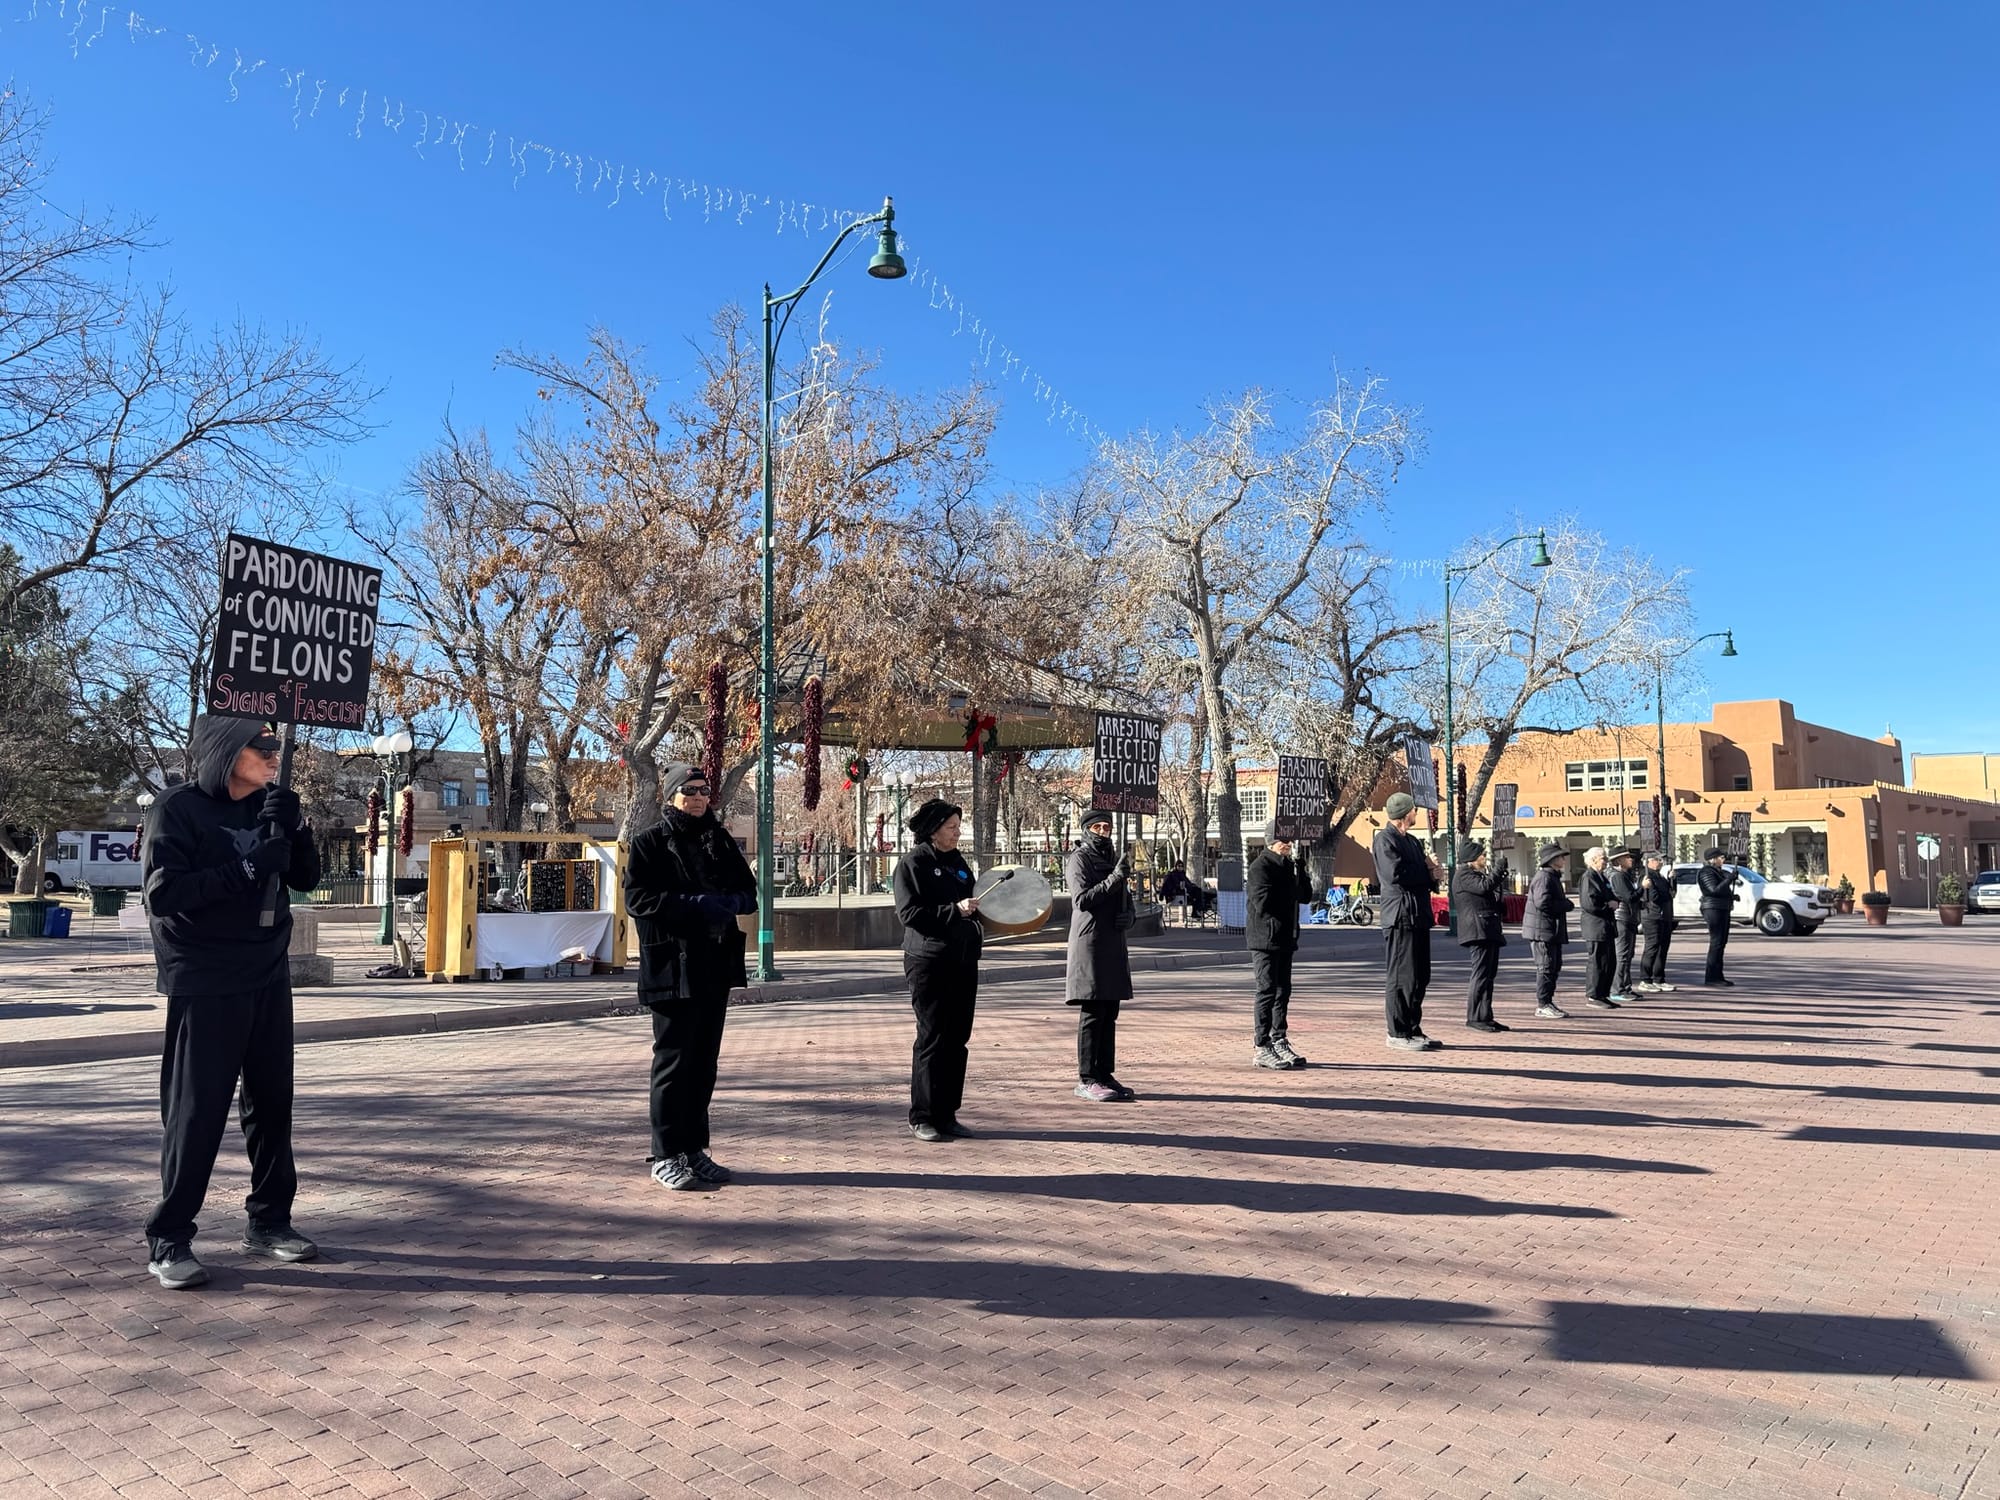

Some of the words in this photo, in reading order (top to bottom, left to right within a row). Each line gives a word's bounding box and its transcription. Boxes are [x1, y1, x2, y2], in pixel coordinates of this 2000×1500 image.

[227, 540, 379, 607] PARDONING
[224, 592, 243, 615] of
[247, 590, 376, 647] CONVICTED
[228, 630, 353, 684] FELONS
[279, 679, 293, 698] of
[1097, 716, 1160, 740] ARRESTING
[1100, 736, 1156, 762] ELECTED
[1094, 759, 1158, 785] OFFICIALS
[1280, 757, 1325, 778] ERASING
[1278, 777, 1325, 797] PERSONAL
[1277, 796, 1325, 816] FREEDOMS
[1538, 806, 1566, 818] First
[1567, 803, 1620, 818] National
